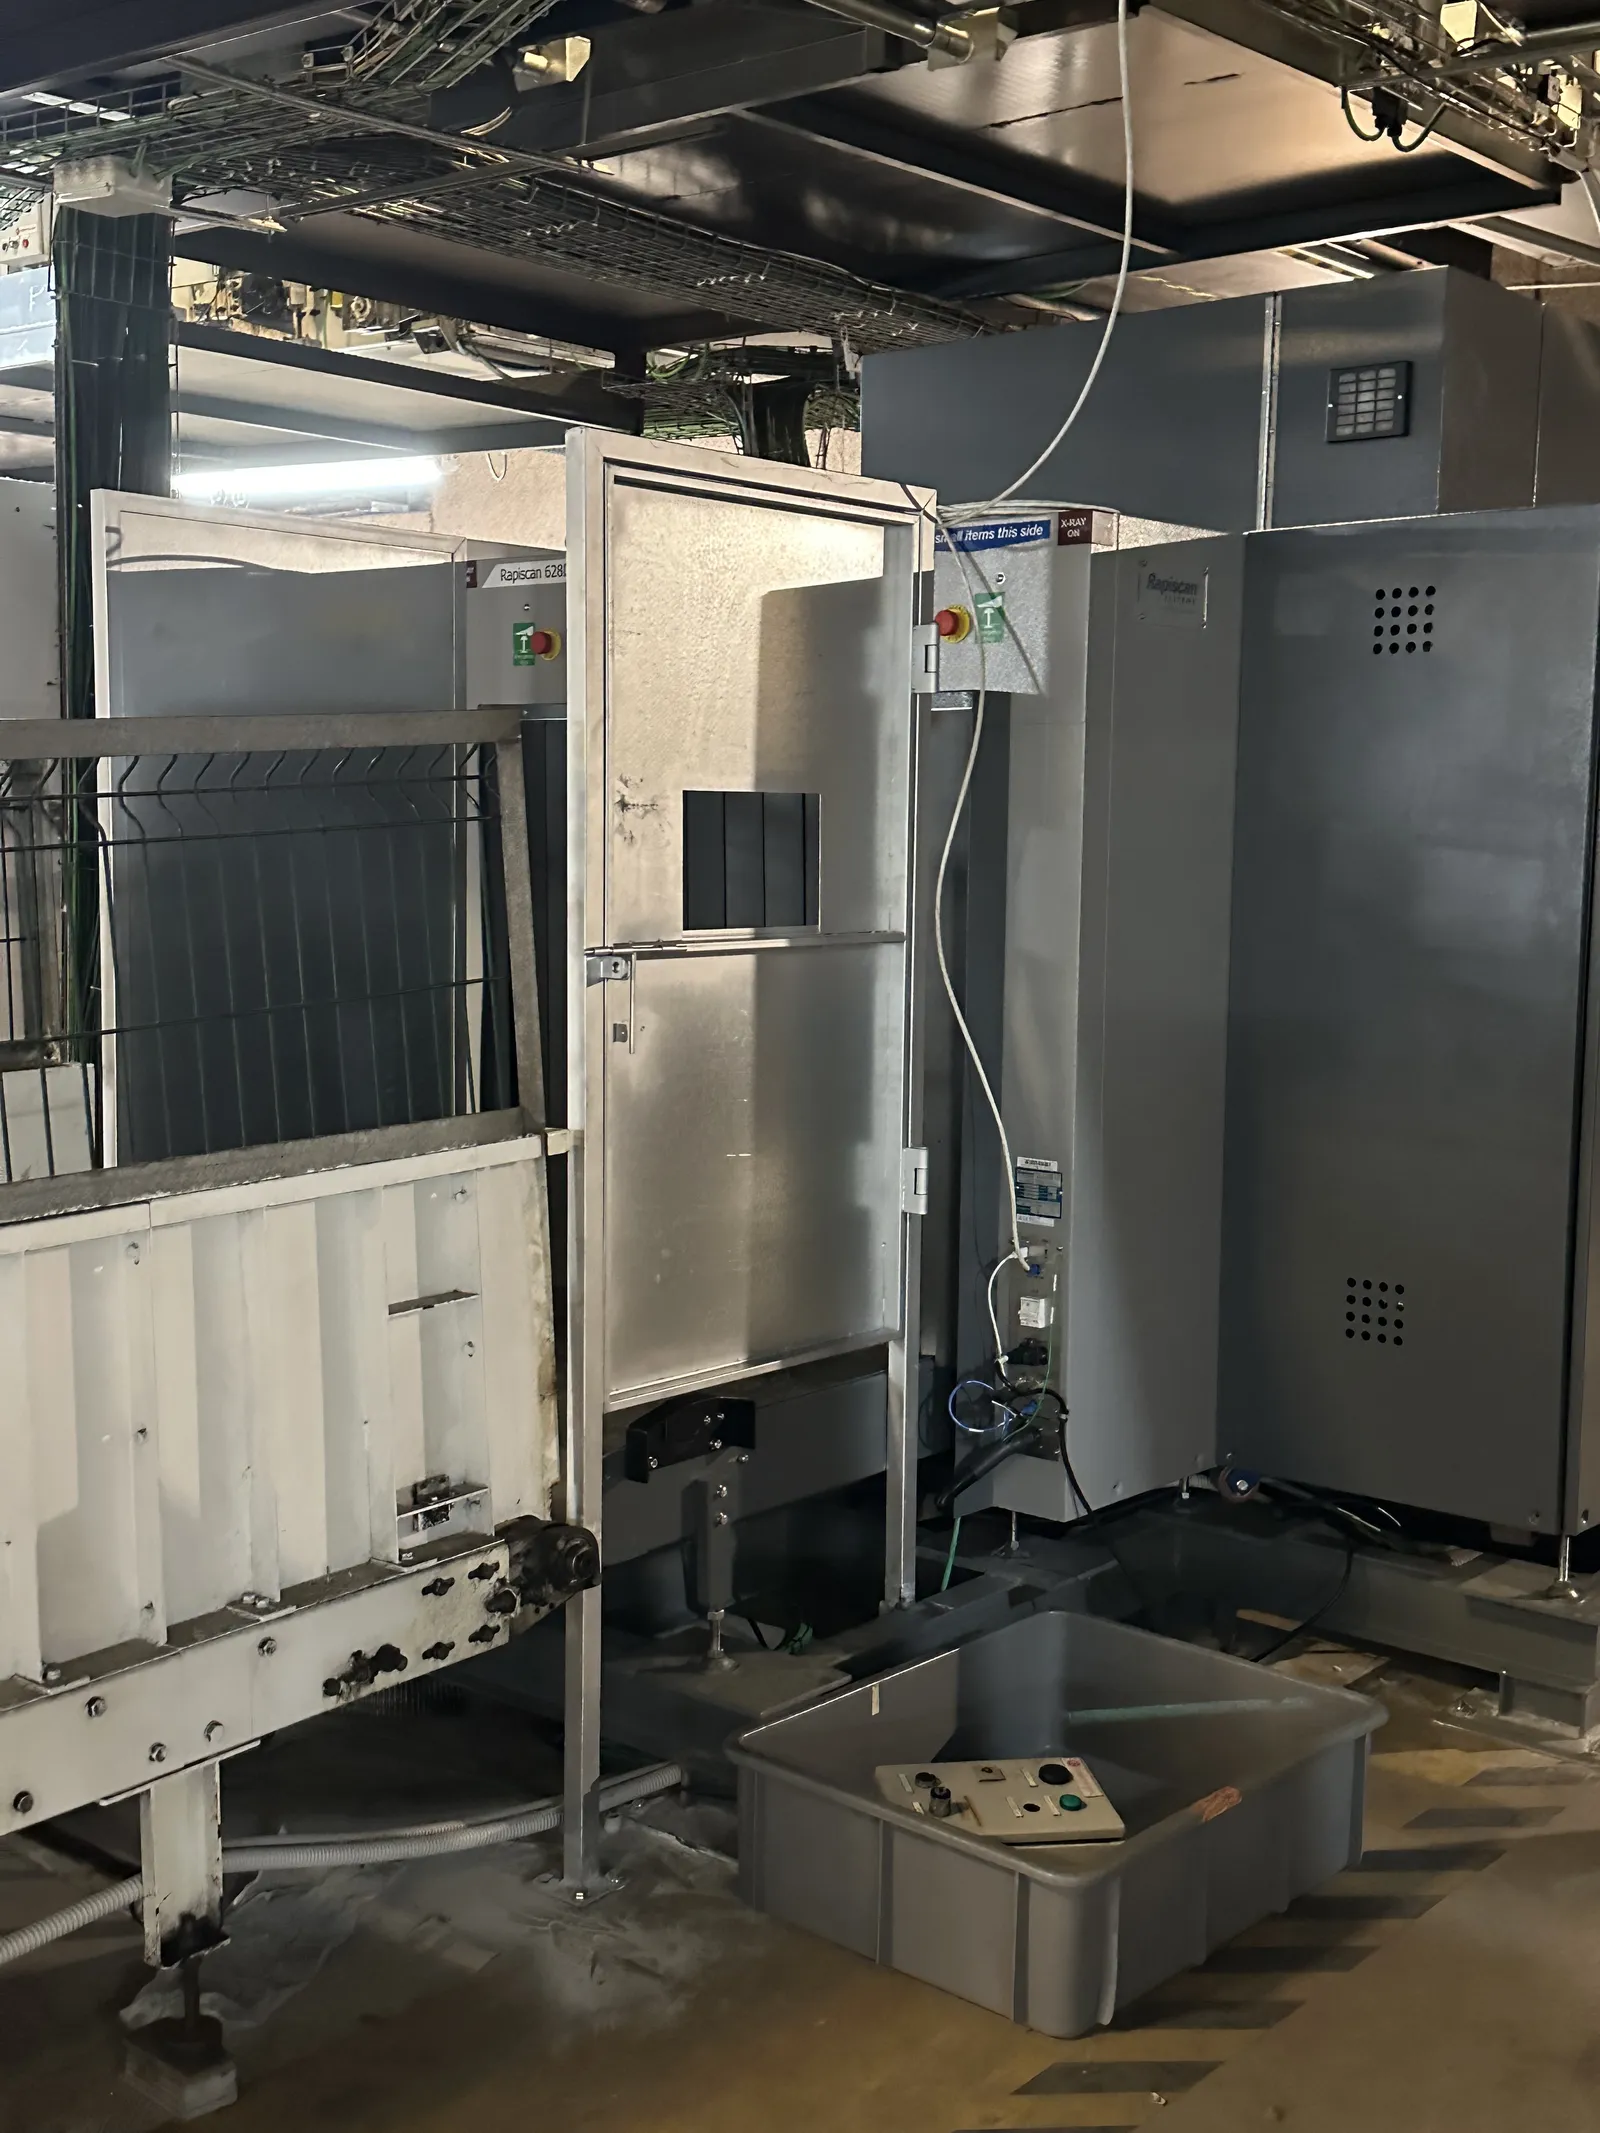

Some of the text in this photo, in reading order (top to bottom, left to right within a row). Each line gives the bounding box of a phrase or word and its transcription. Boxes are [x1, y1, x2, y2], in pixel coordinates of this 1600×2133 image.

[1060, 517, 1087, 528] X-RAY
[964, 529, 996, 542] items
[998, 526, 1018, 540] this
[1020, 523, 1044, 537] side
[1067, 529, 1080, 538] ON
[500, 563, 567, 584] Rapiscan 628
[1146, 572, 1198, 596] Rapiscan
